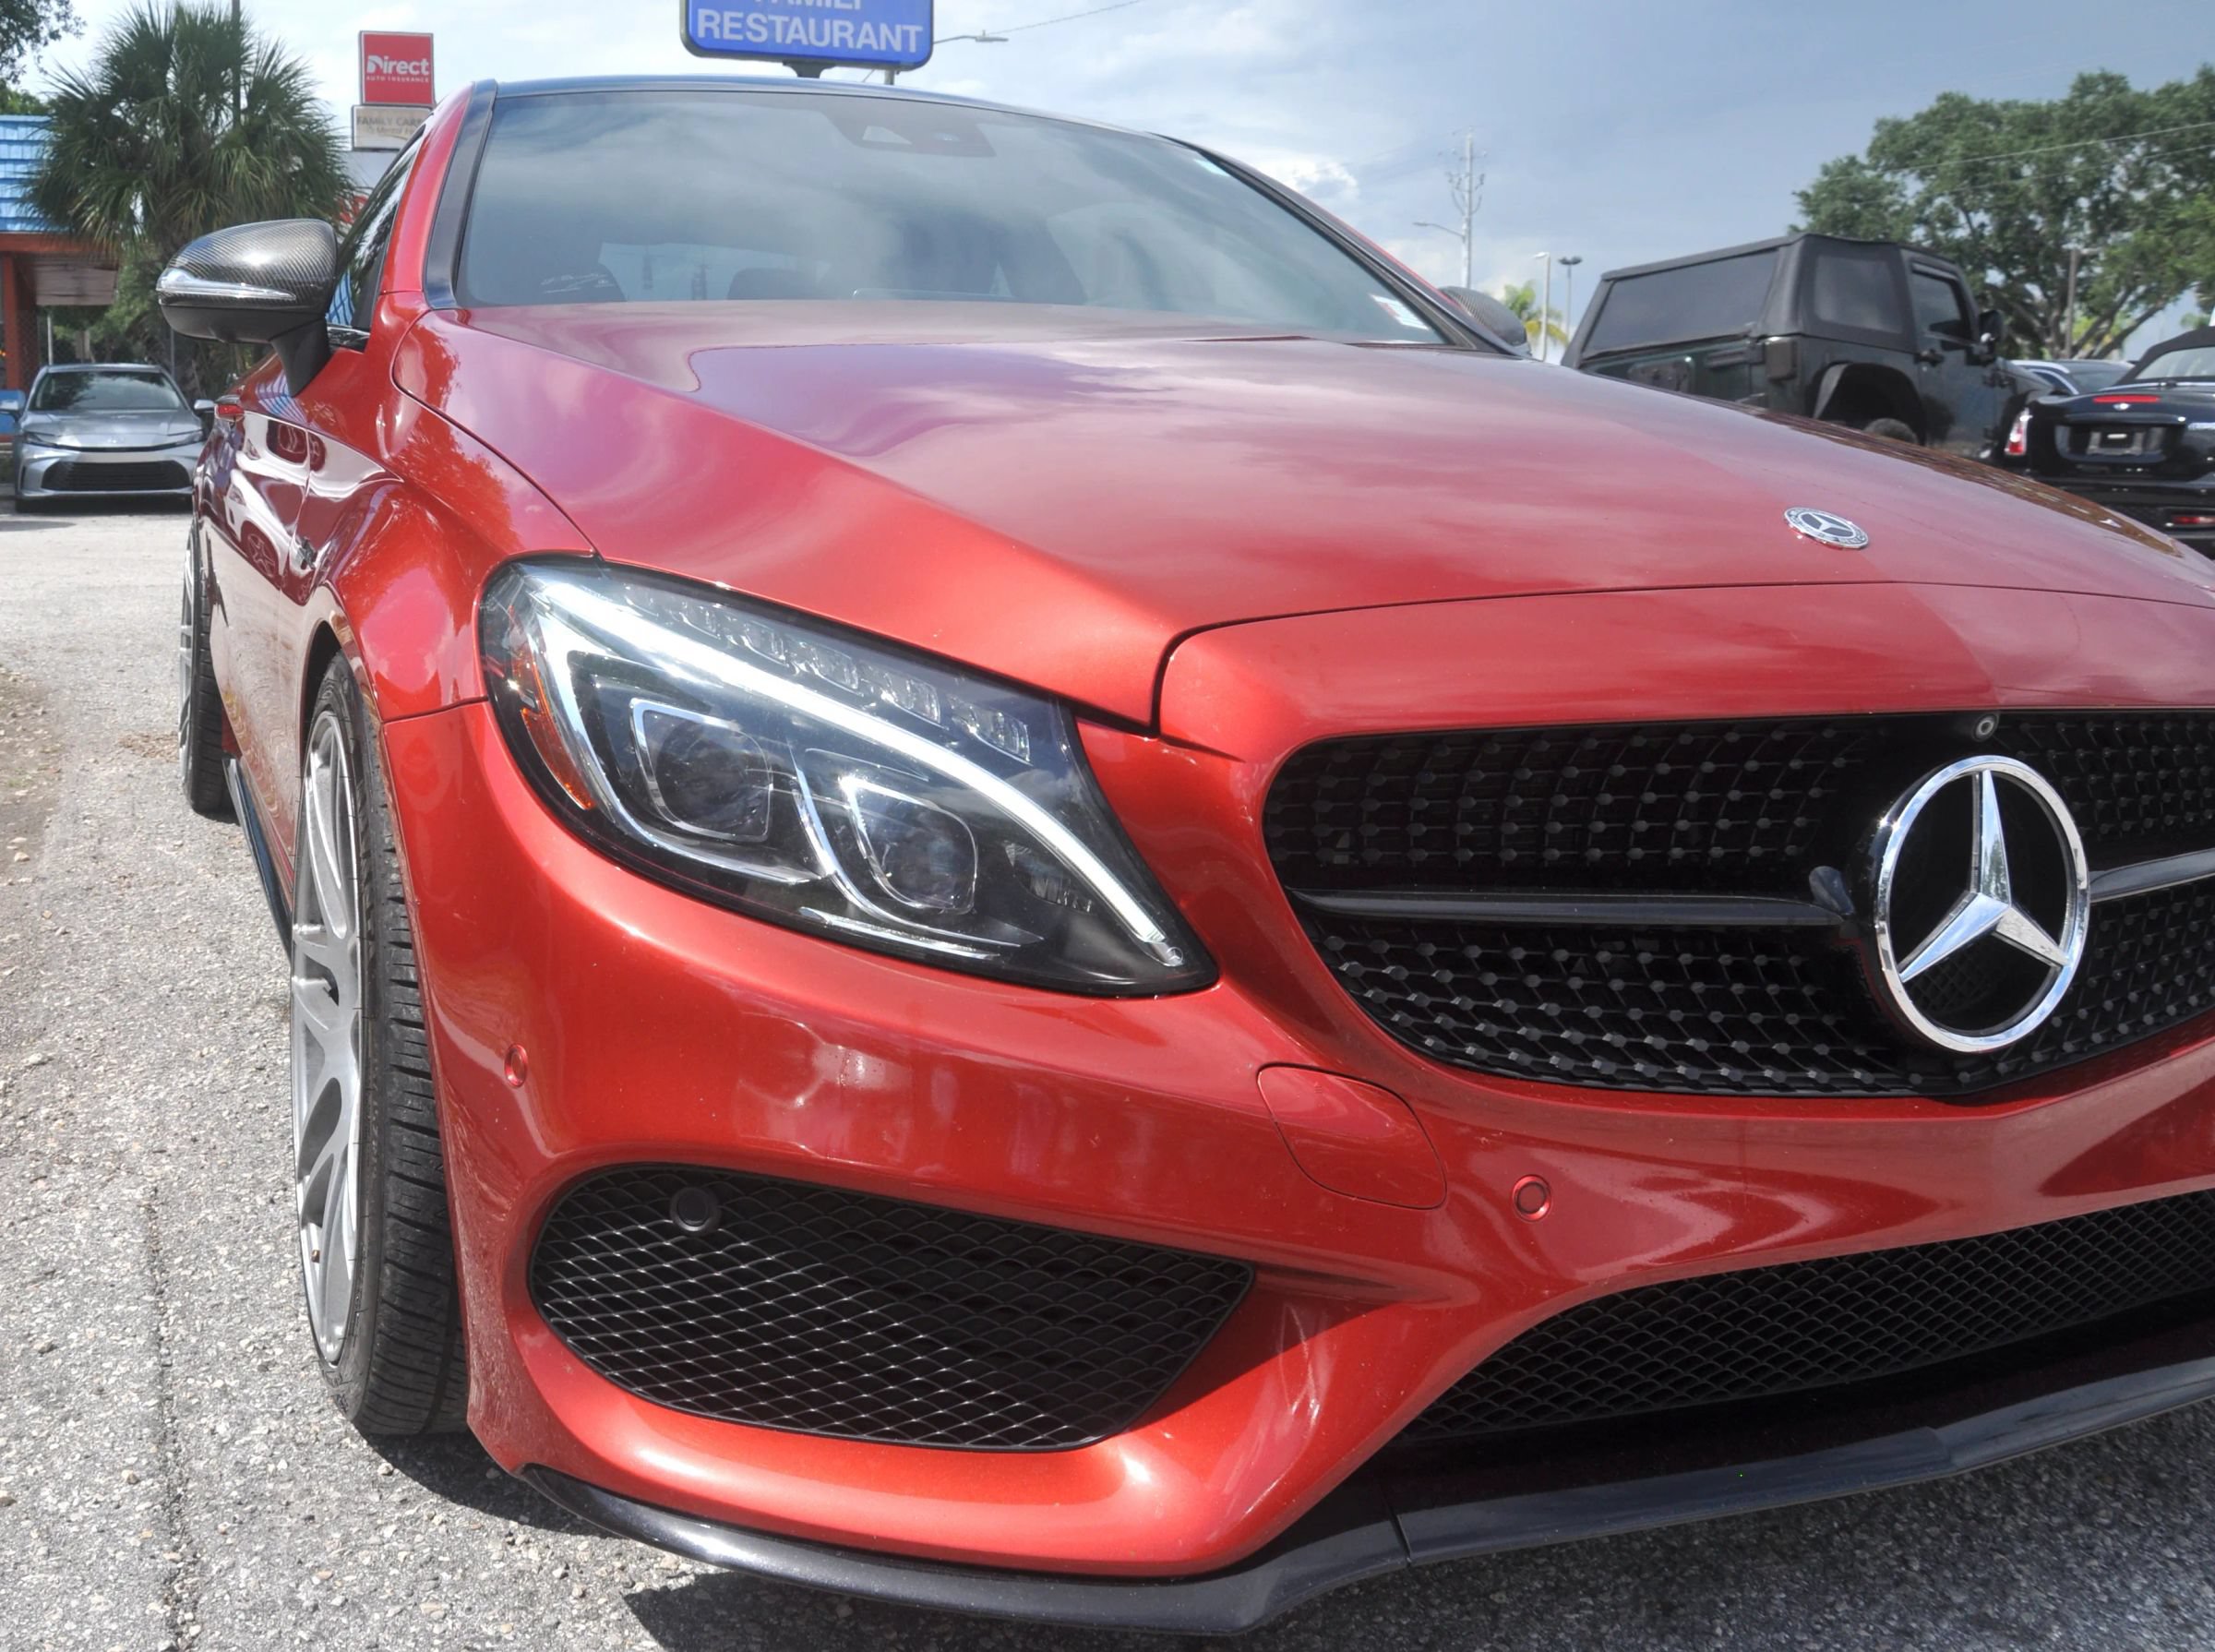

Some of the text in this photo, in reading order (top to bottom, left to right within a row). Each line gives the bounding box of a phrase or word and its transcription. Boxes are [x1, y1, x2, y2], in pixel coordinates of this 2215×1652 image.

[698, 8, 923, 53] RESTAURANT
[366, 55, 429, 76] Direct
[357, 116, 393, 126] FAMILY
